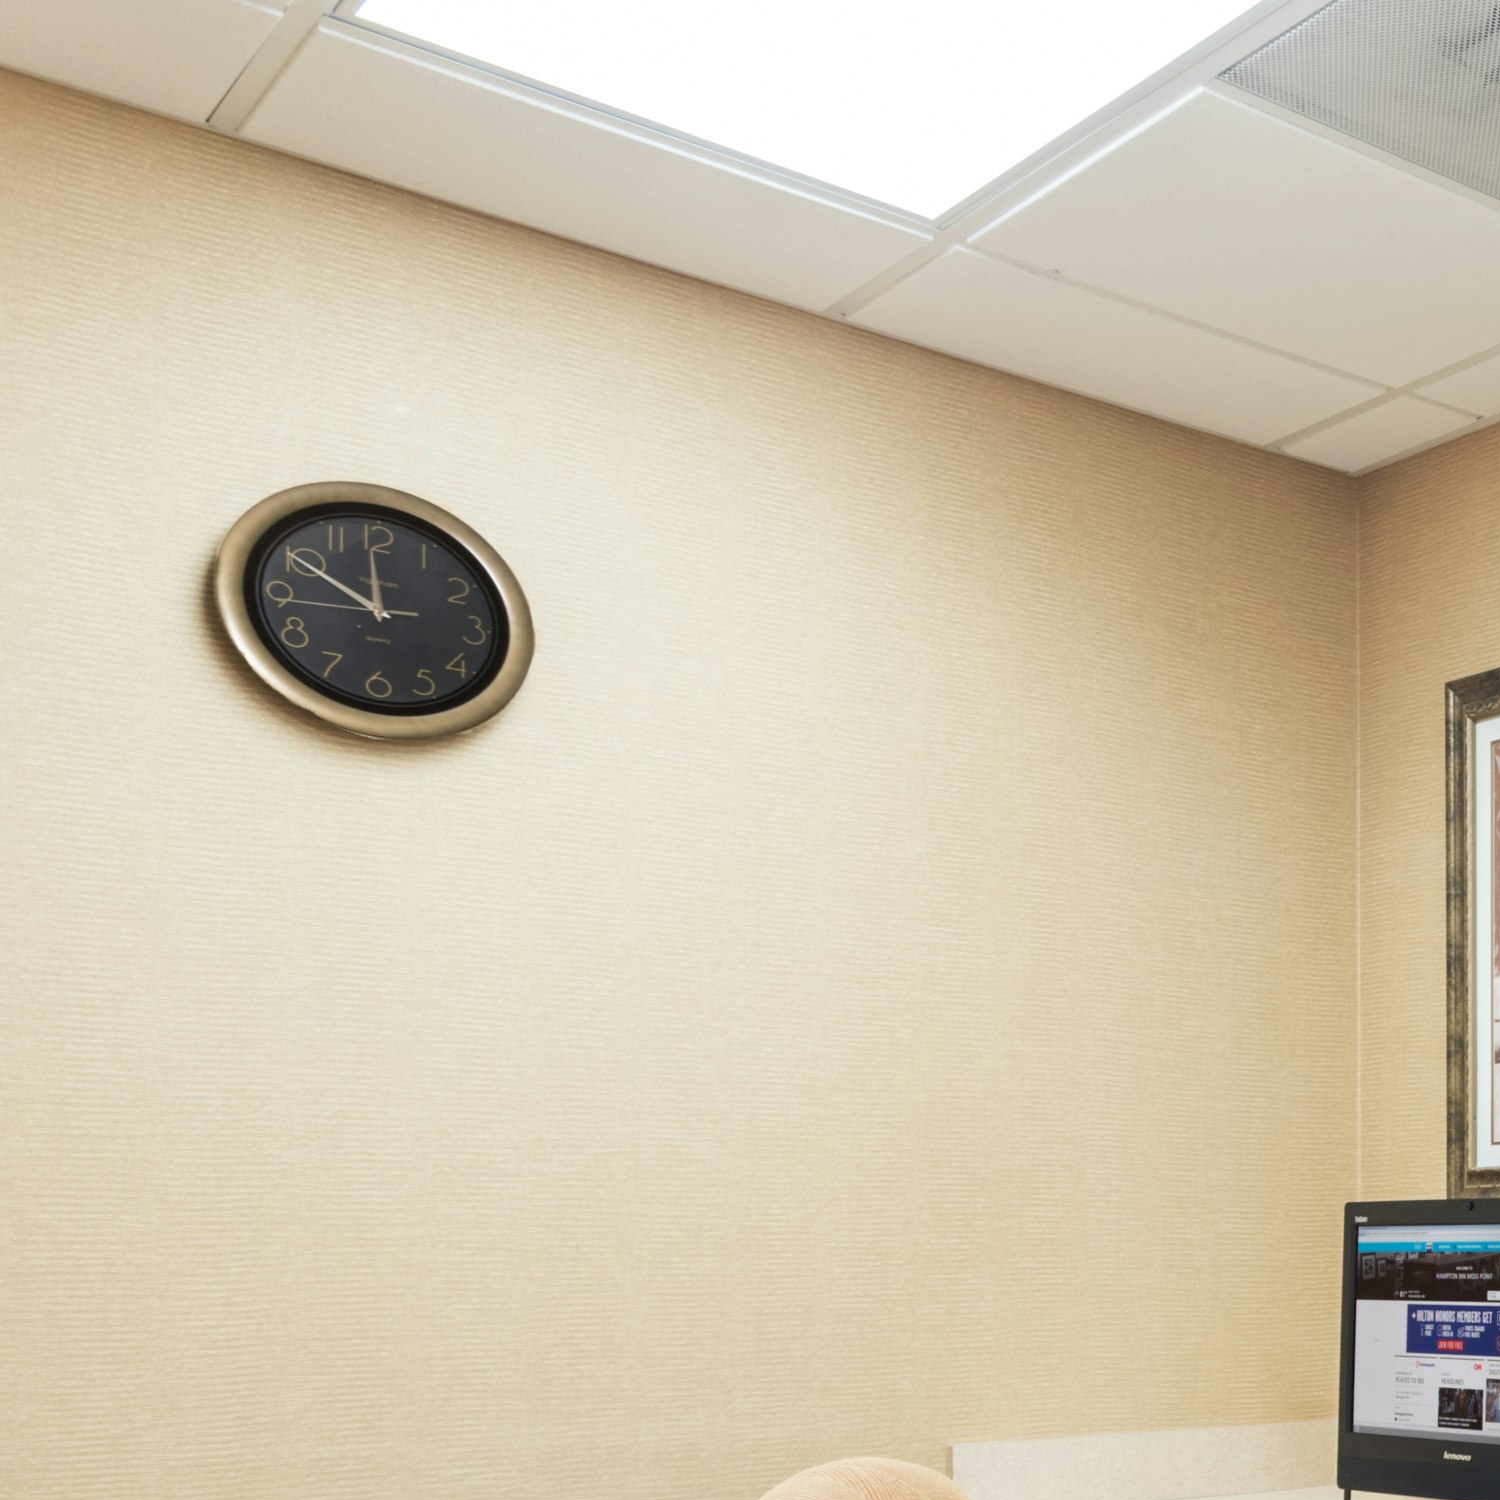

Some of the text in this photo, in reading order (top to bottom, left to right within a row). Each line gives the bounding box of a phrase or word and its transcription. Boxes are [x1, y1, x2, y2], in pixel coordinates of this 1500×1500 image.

[328, 525, 344, 552] 11
[364, 523, 394, 554] 12
[286, 546, 326, 576] 10
[421, 544, 426, 569] 1
[266, 581, 293, 608] 9
[447, 577, 469, 605] 2
[280, 617, 309, 648] 8
[462, 616, 486, 645] 3
[321, 651, 343, 677] 7
[446, 652, 467, 678] 4
[365, 671, 392, 698] 6
[412, 669, 435, 696] 5
[1416, 1310, 1493, 1324] HILTON HONORS MEMBERS GET
[1443, 1451, 1471, 1461] lenovo
